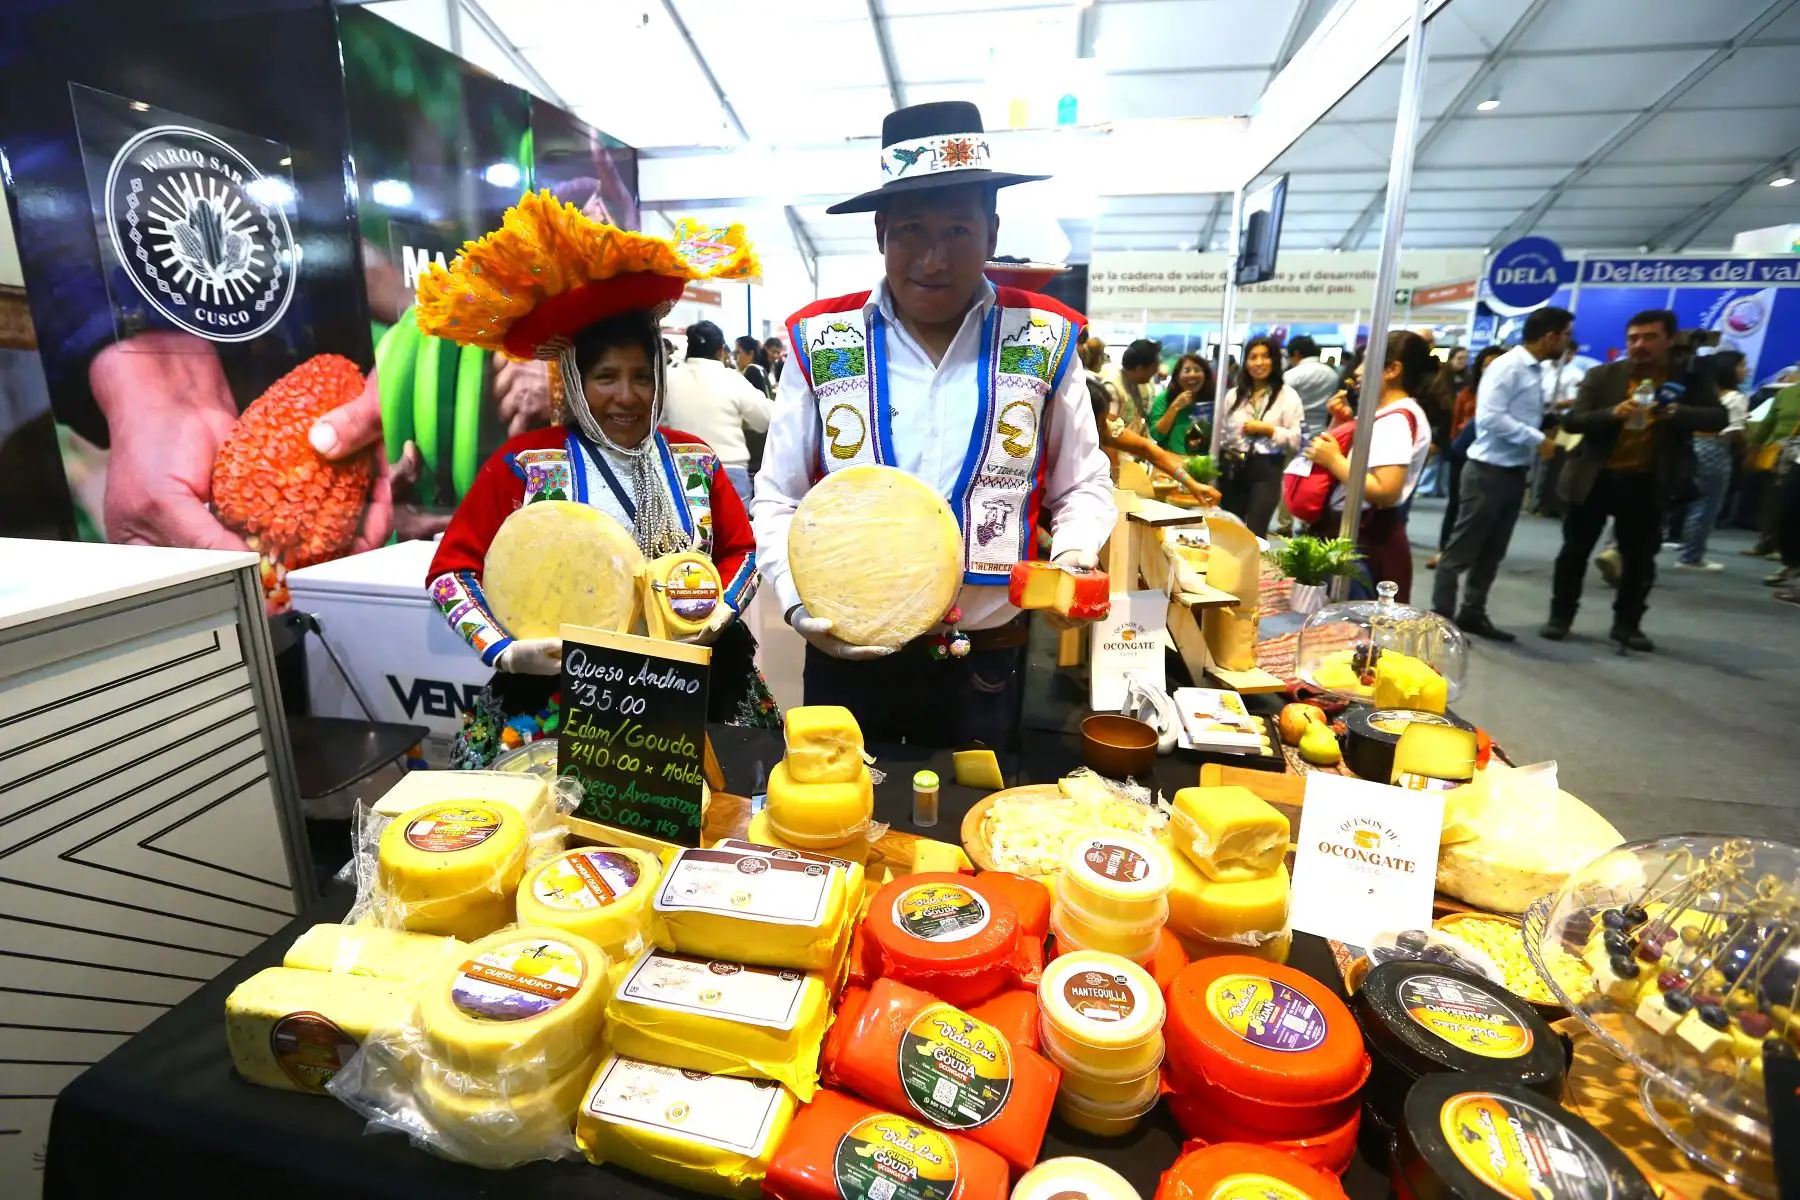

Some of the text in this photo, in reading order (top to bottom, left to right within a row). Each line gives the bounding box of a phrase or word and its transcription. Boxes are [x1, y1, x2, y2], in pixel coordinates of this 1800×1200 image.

[141, 148, 244, 185] WAROQ SAR
[1107, 271, 1118, 280] la
[1120, 271, 1164, 280] cadena
[1168, 271, 1182, 280] de
[1186, 271, 1215, 280] valor
[1299, 270, 1311, 280] el
[1495, 266, 1558, 285] DELA
[1590, 261, 1704, 283] Deleites
[1709, 260, 1753, 281] del
[1107, 285, 1114, 295] y
[1117, 284, 1175, 293] medianos
[1179, 284, 1253, 295] productres
[1304, 283, 1324, 293] del
[194, 307, 250, 326] CUSCO
[1103, 641, 1155, 651] OCONGATE
[565, 648, 700, 694] Queso Andino
[386, 674, 484, 720] VEN
[1318, 841, 1416, 874] OCONGATE
[923, 904, 960, 918] GOUDA
[484, 968, 553, 990] QUESO ANDINO
[1071, 986, 1127, 1001] MANTEQUILLA
[933, 1019, 971, 1049] Vida
[970, 1039, 996, 1062] Lac
[933, 1047, 976, 1080] GOUDA
[945, 1047, 971, 1067] QUESO
[938, 1062, 968, 1082] OCONGATE
[875, 1125, 915, 1153] Vida
[914, 1144, 942, 1165] Lac
[873, 1150, 919, 1180] GOUDA
[886, 1149, 914, 1167] QUESO
[877, 1163, 909, 1182] OCONGATE
